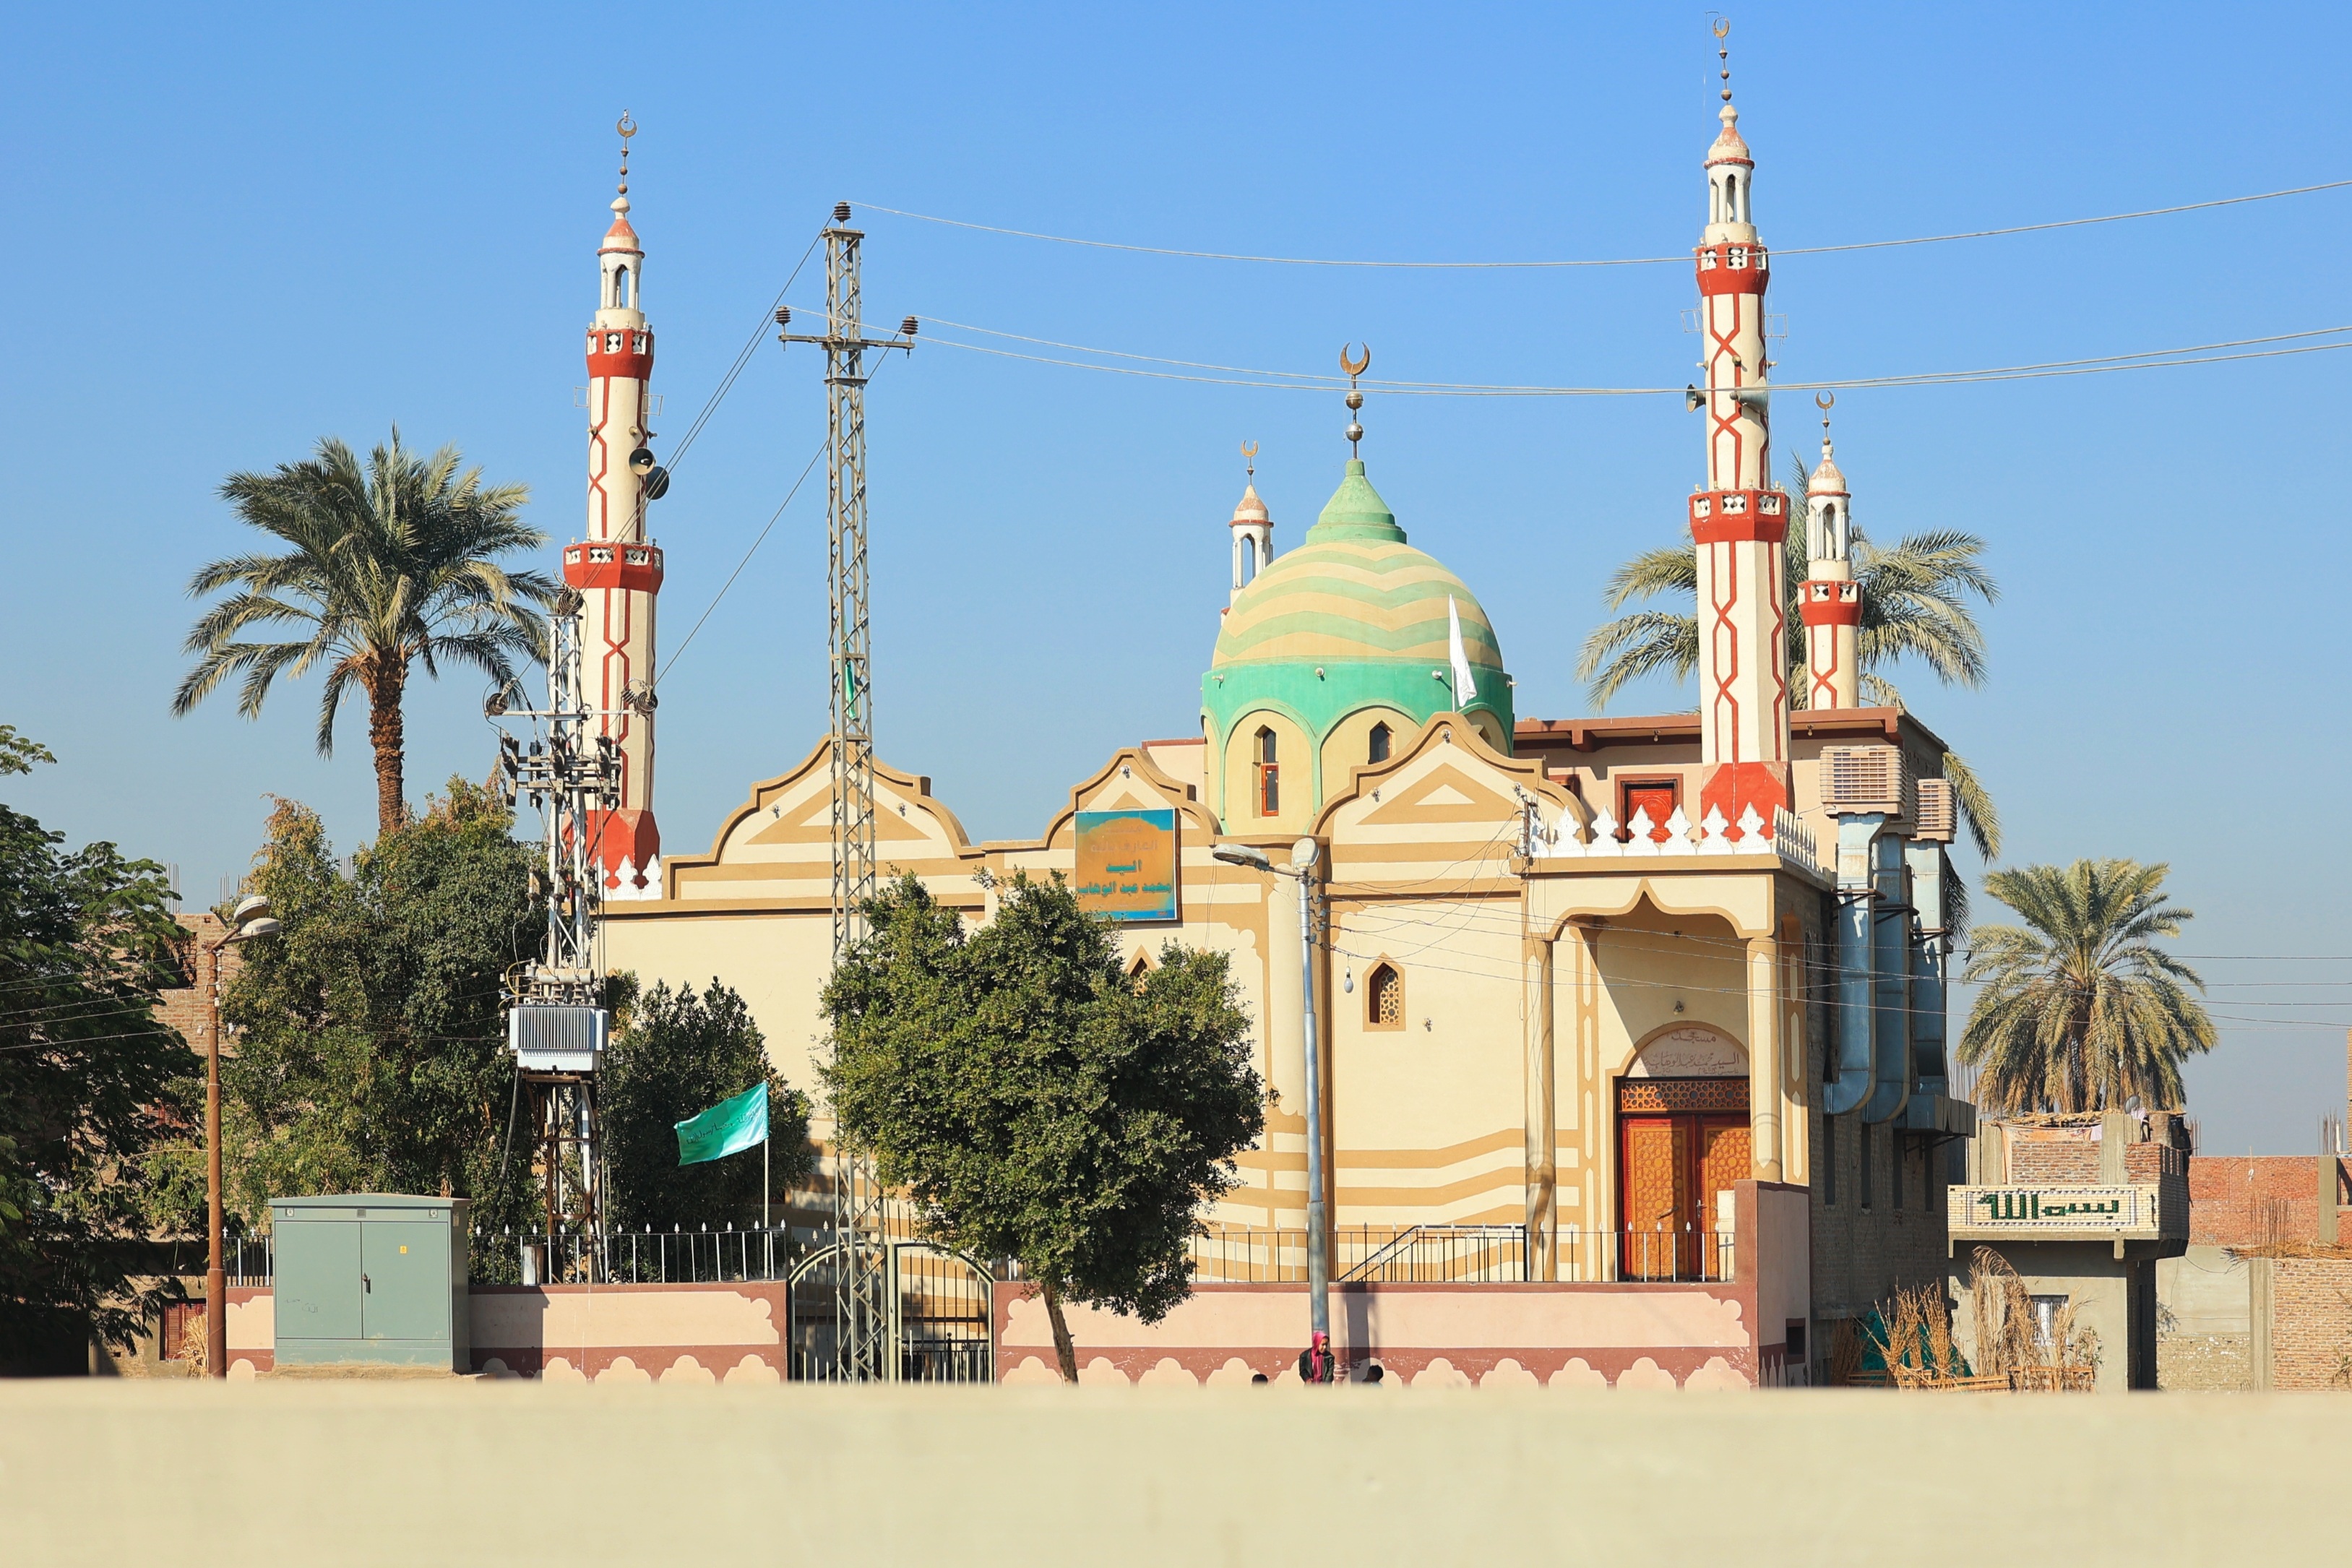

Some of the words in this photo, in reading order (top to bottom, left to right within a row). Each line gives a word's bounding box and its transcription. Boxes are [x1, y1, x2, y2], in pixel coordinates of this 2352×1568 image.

[1091, 841, 1115, 852] بالله
[1119, 840, 1158, 854] العارف
[1106, 859, 1142, 876] السيد
[1077, 881, 1116, 896] الوهاب
[1119, 882, 1138, 897] عبد
[1142, 882, 1171, 893] محمد
[1671, 1030, 1716, 1044] مسجد
[1689, 1052, 1714, 1067] محمد
[1711, 1052, 1740, 1069] السيد
[1977, 1193, 2039, 1220] الله
[2041, 1199, 2119, 1220] بسم
